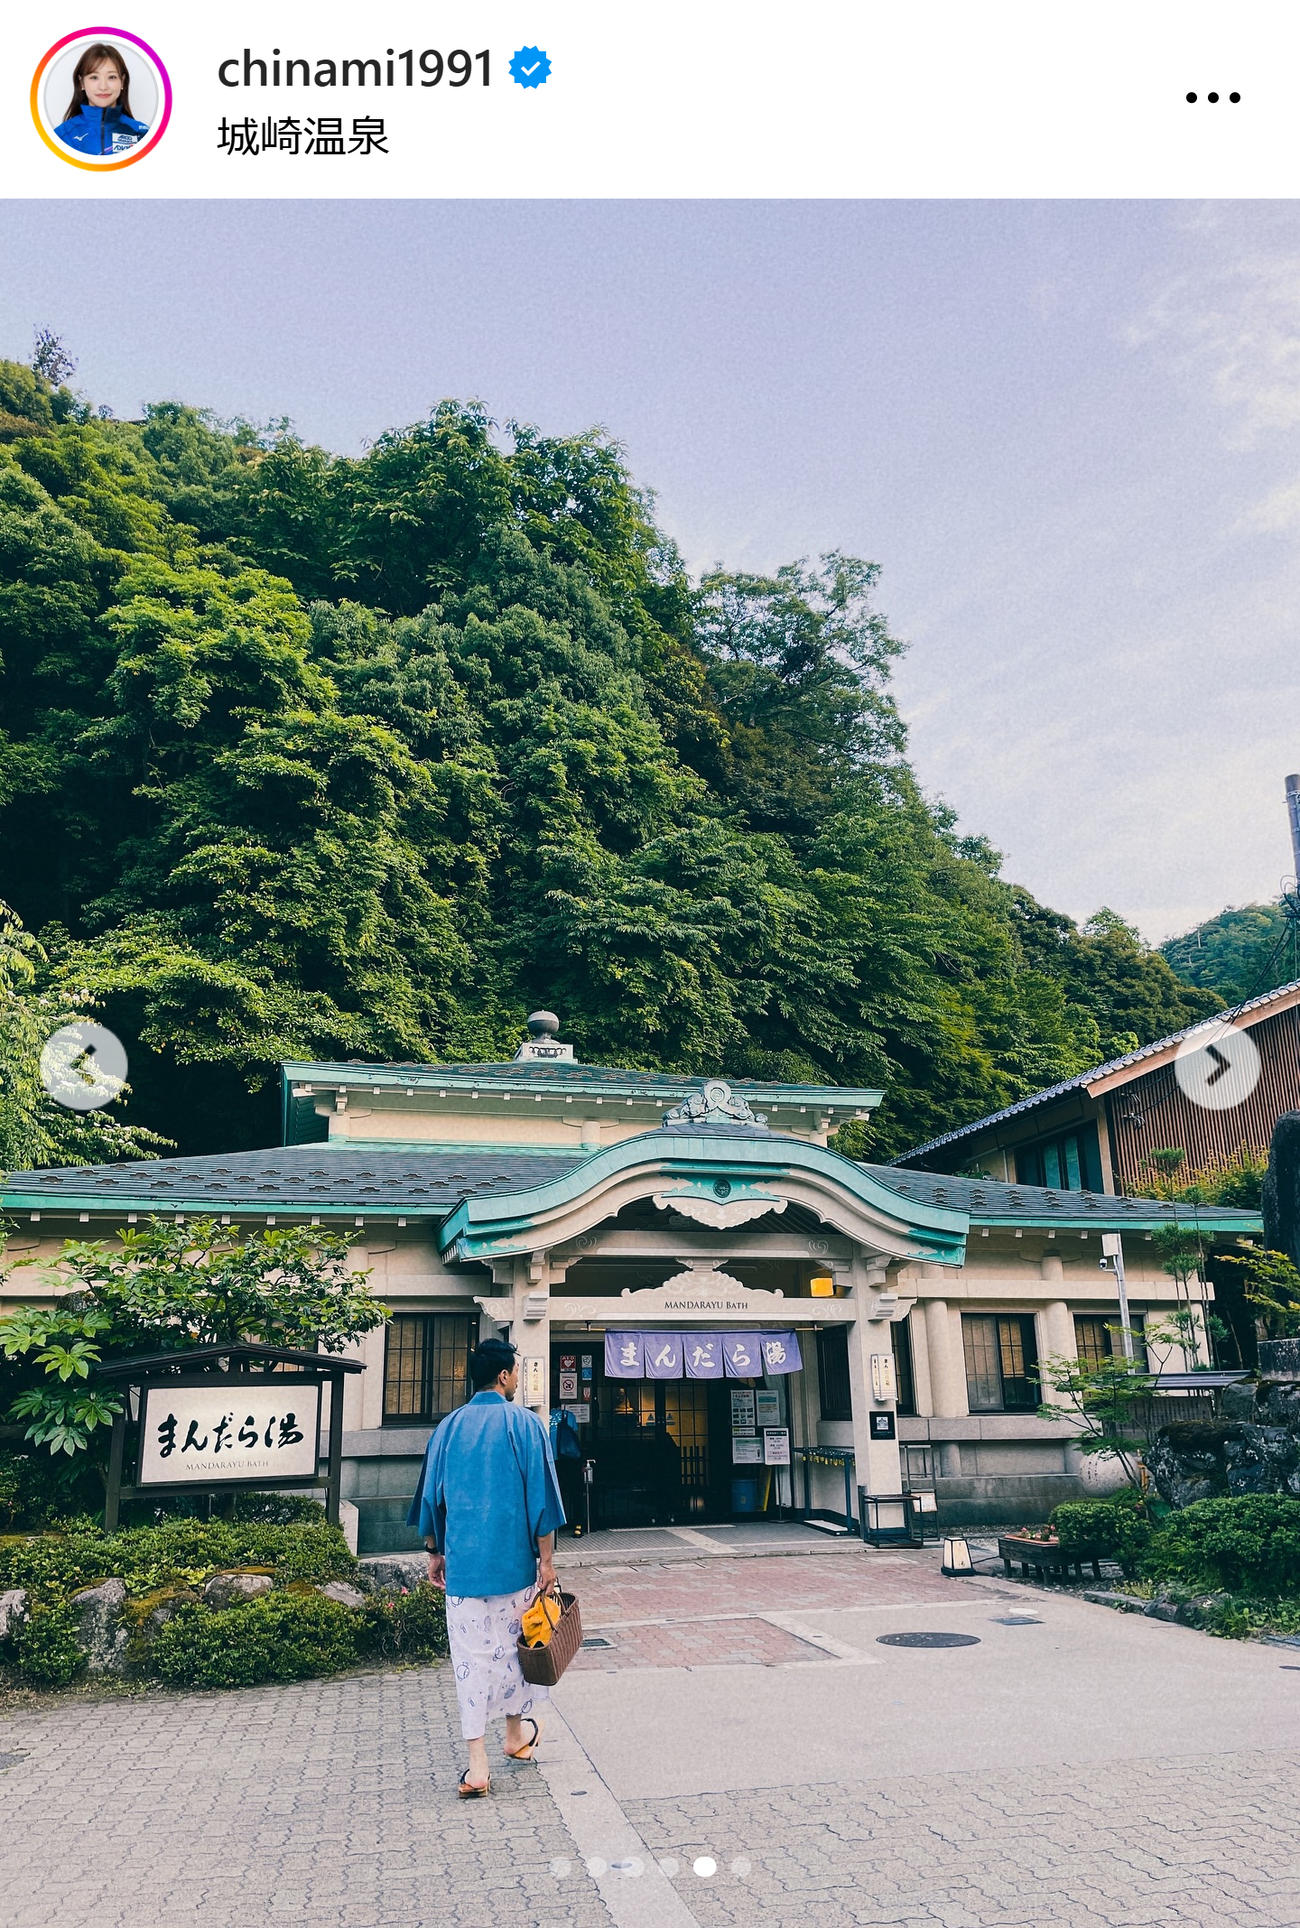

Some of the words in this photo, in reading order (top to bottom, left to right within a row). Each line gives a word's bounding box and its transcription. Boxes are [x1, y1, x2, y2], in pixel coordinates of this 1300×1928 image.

[664, 1300, 723, 1310] MANDARAYU
[620, 1341, 787, 1368] まんだら湯
[158, 1413, 303, 1458] まんだら湯
[185, 1460, 245, 1471] MANDARAYU
[246, 1460, 269, 1468] BATH
